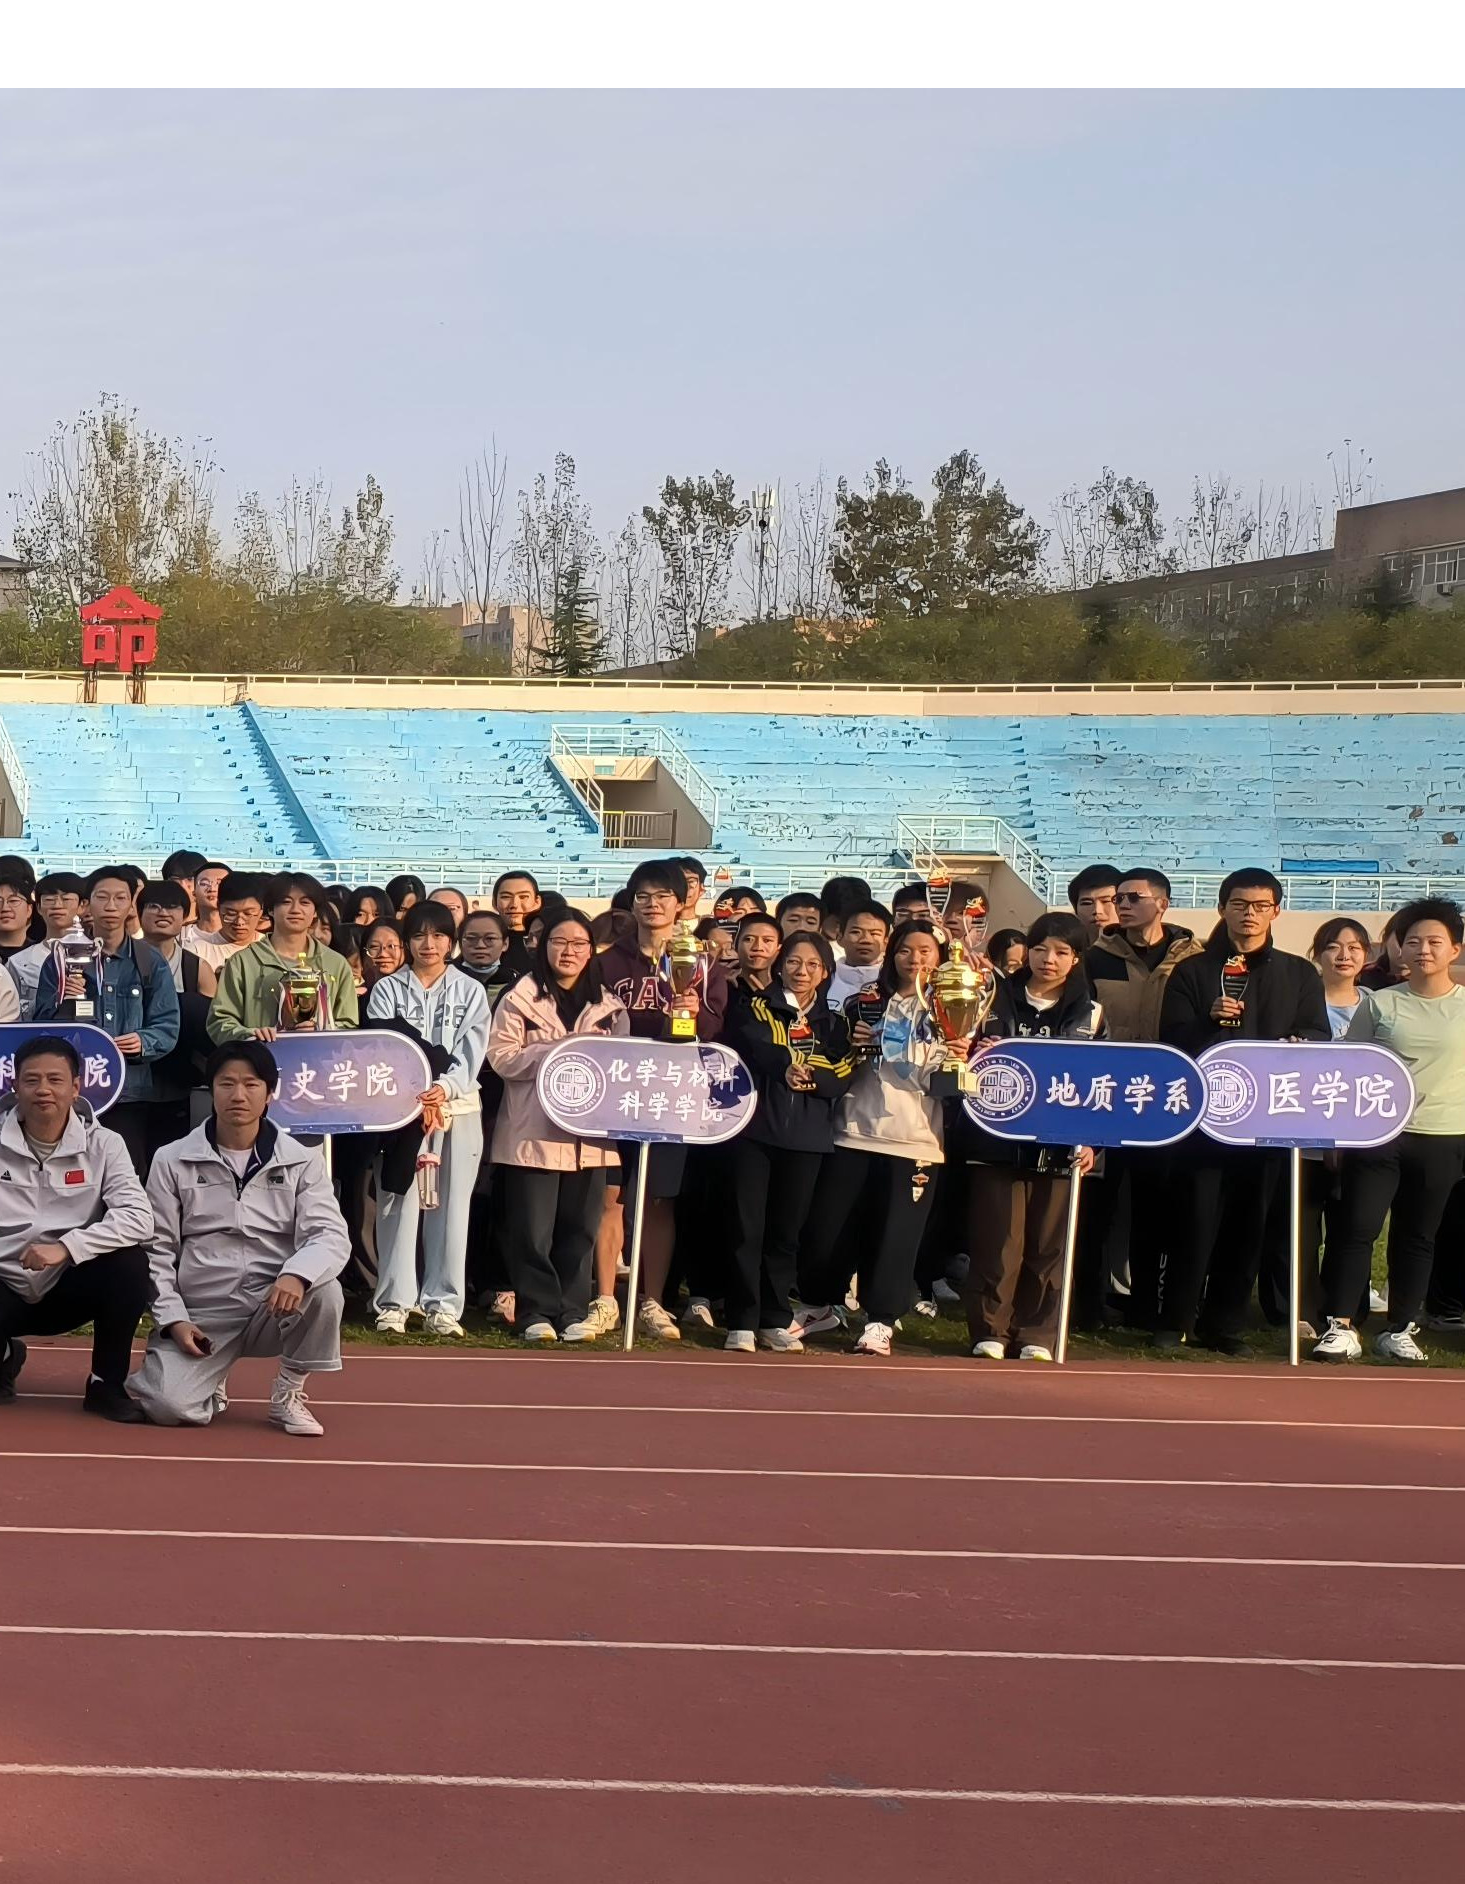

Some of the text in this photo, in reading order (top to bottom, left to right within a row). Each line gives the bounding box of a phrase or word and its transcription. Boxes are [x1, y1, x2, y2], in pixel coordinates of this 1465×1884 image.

[619, 1090, 724, 1122] 科学学院
[1046, 1072, 1191, 1115] 地质学系
[1267, 1069, 1398, 1120] 医学院
